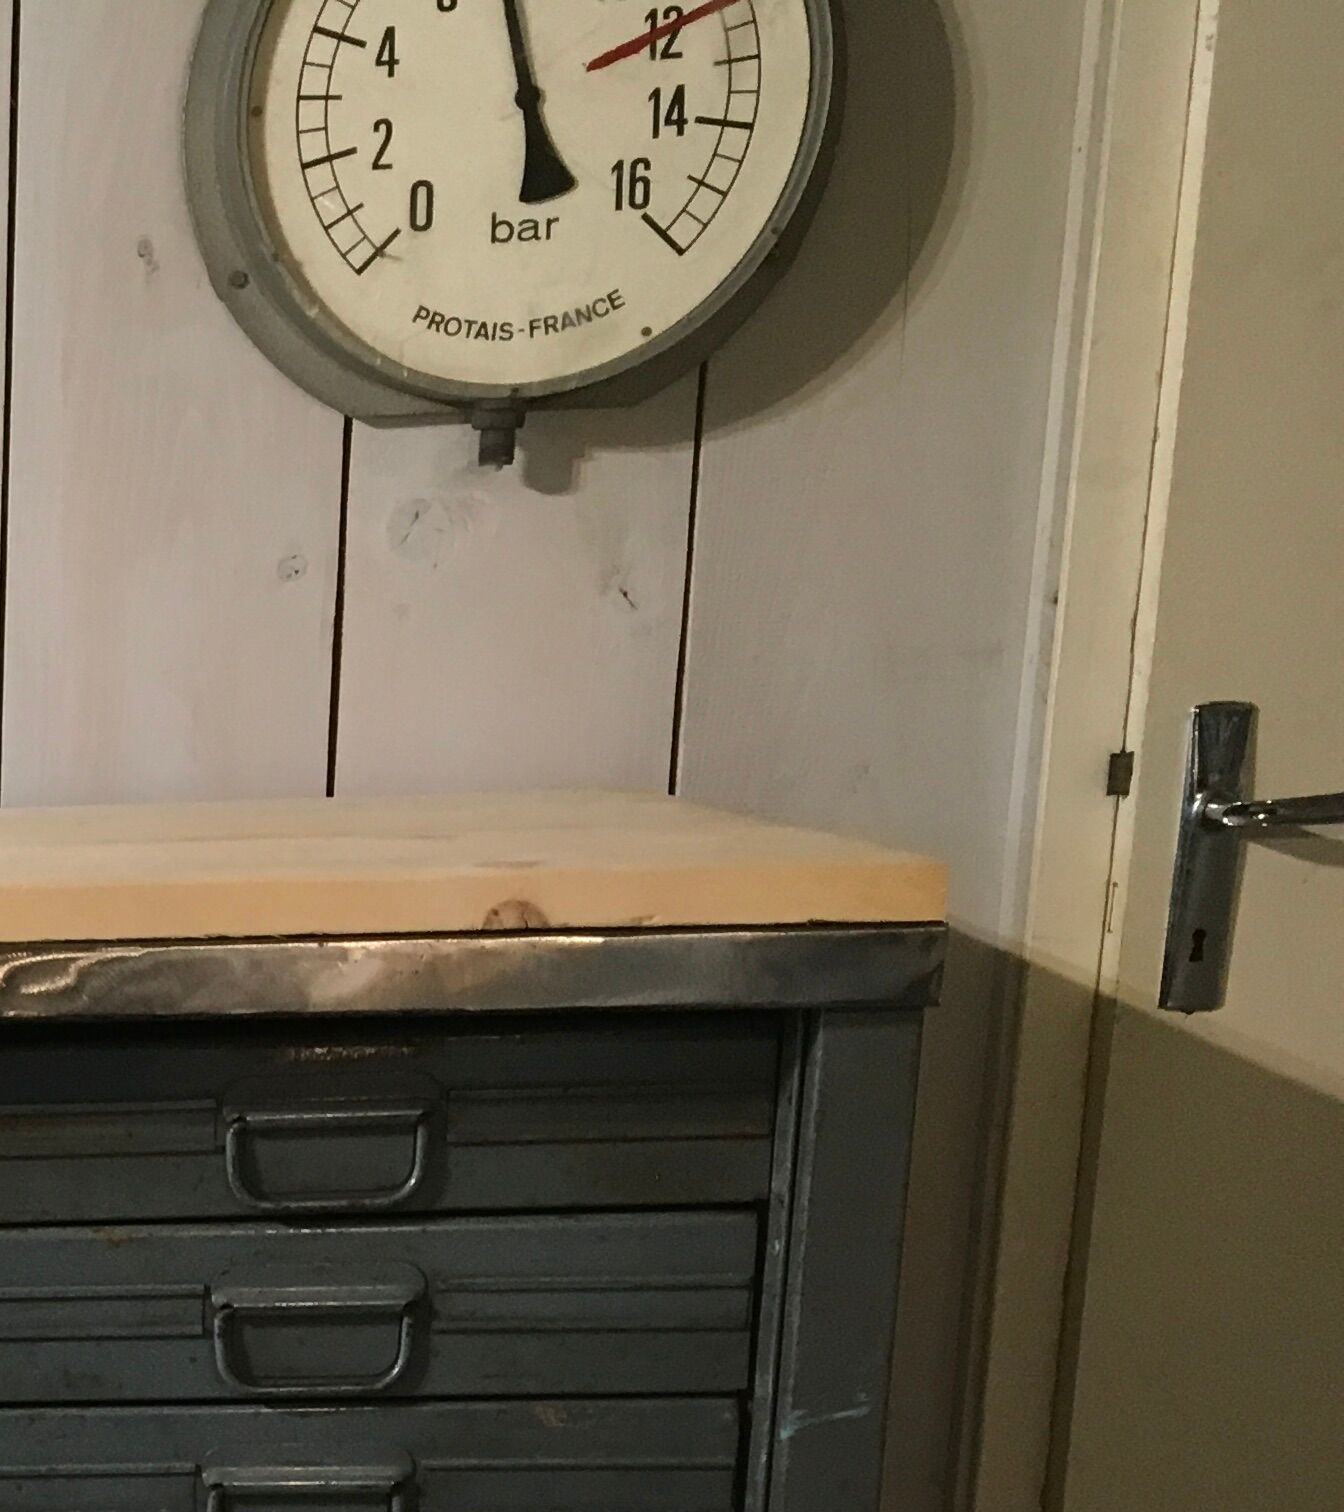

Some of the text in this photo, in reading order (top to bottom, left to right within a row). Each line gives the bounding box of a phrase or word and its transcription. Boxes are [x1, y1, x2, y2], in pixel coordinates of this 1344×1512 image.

[375, 25, 400, 78] 4
[644, 5, 684, 61] 12
[648, 84, 689, 139] 14
[372, 118, 393, 171] 2
[410, 179, 435, 232] 0
[611, 157, 652, 211] 16
[490, 211, 560, 243] bar
